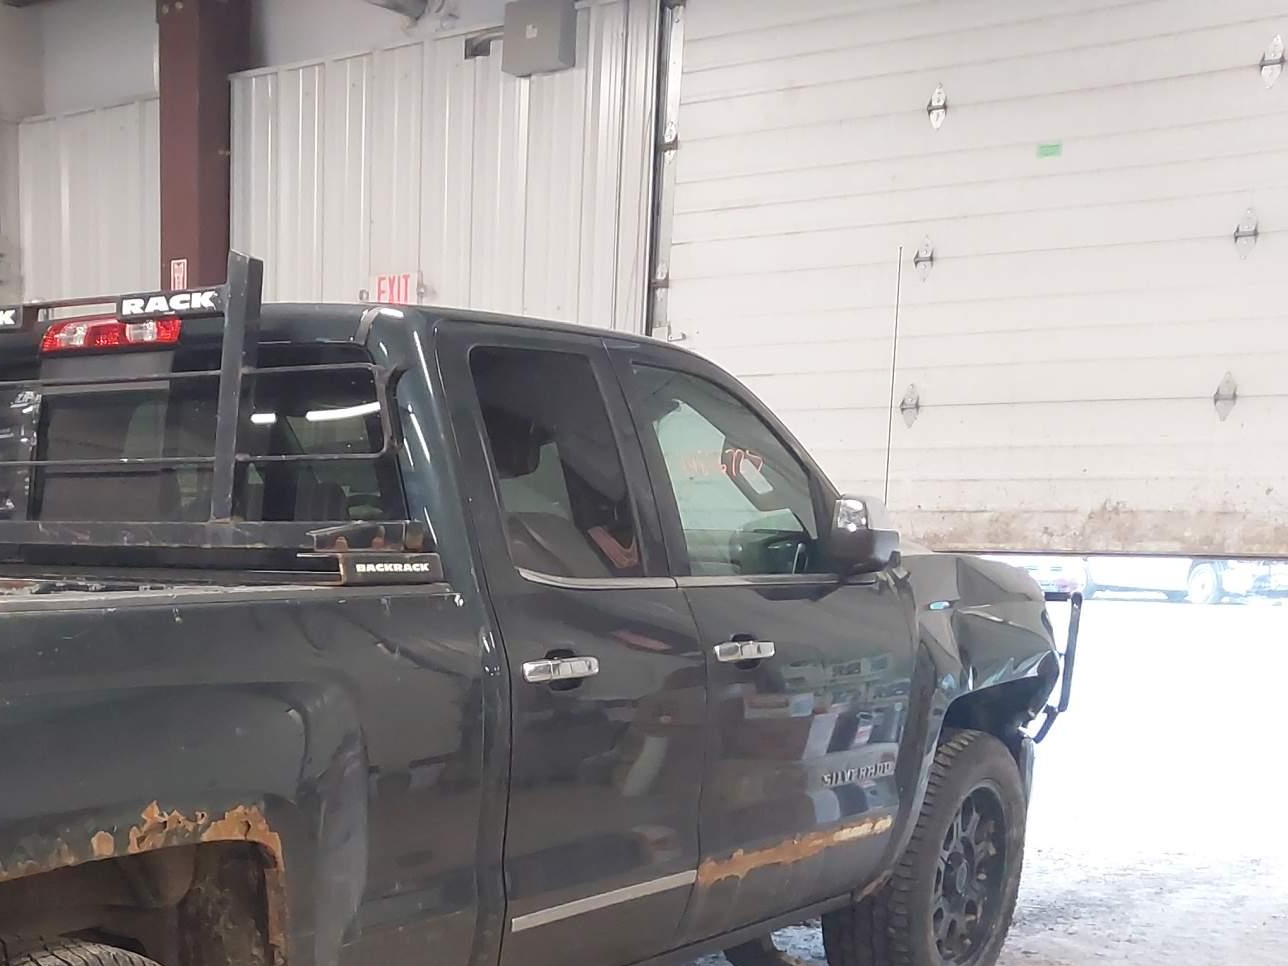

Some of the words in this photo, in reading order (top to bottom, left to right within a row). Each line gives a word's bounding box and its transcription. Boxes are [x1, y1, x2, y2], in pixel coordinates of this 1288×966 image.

[376, 273, 411, 305] EXIT
[122, 291, 217, 315] RACK
[355, 563, 430, 572] BACKRACK
